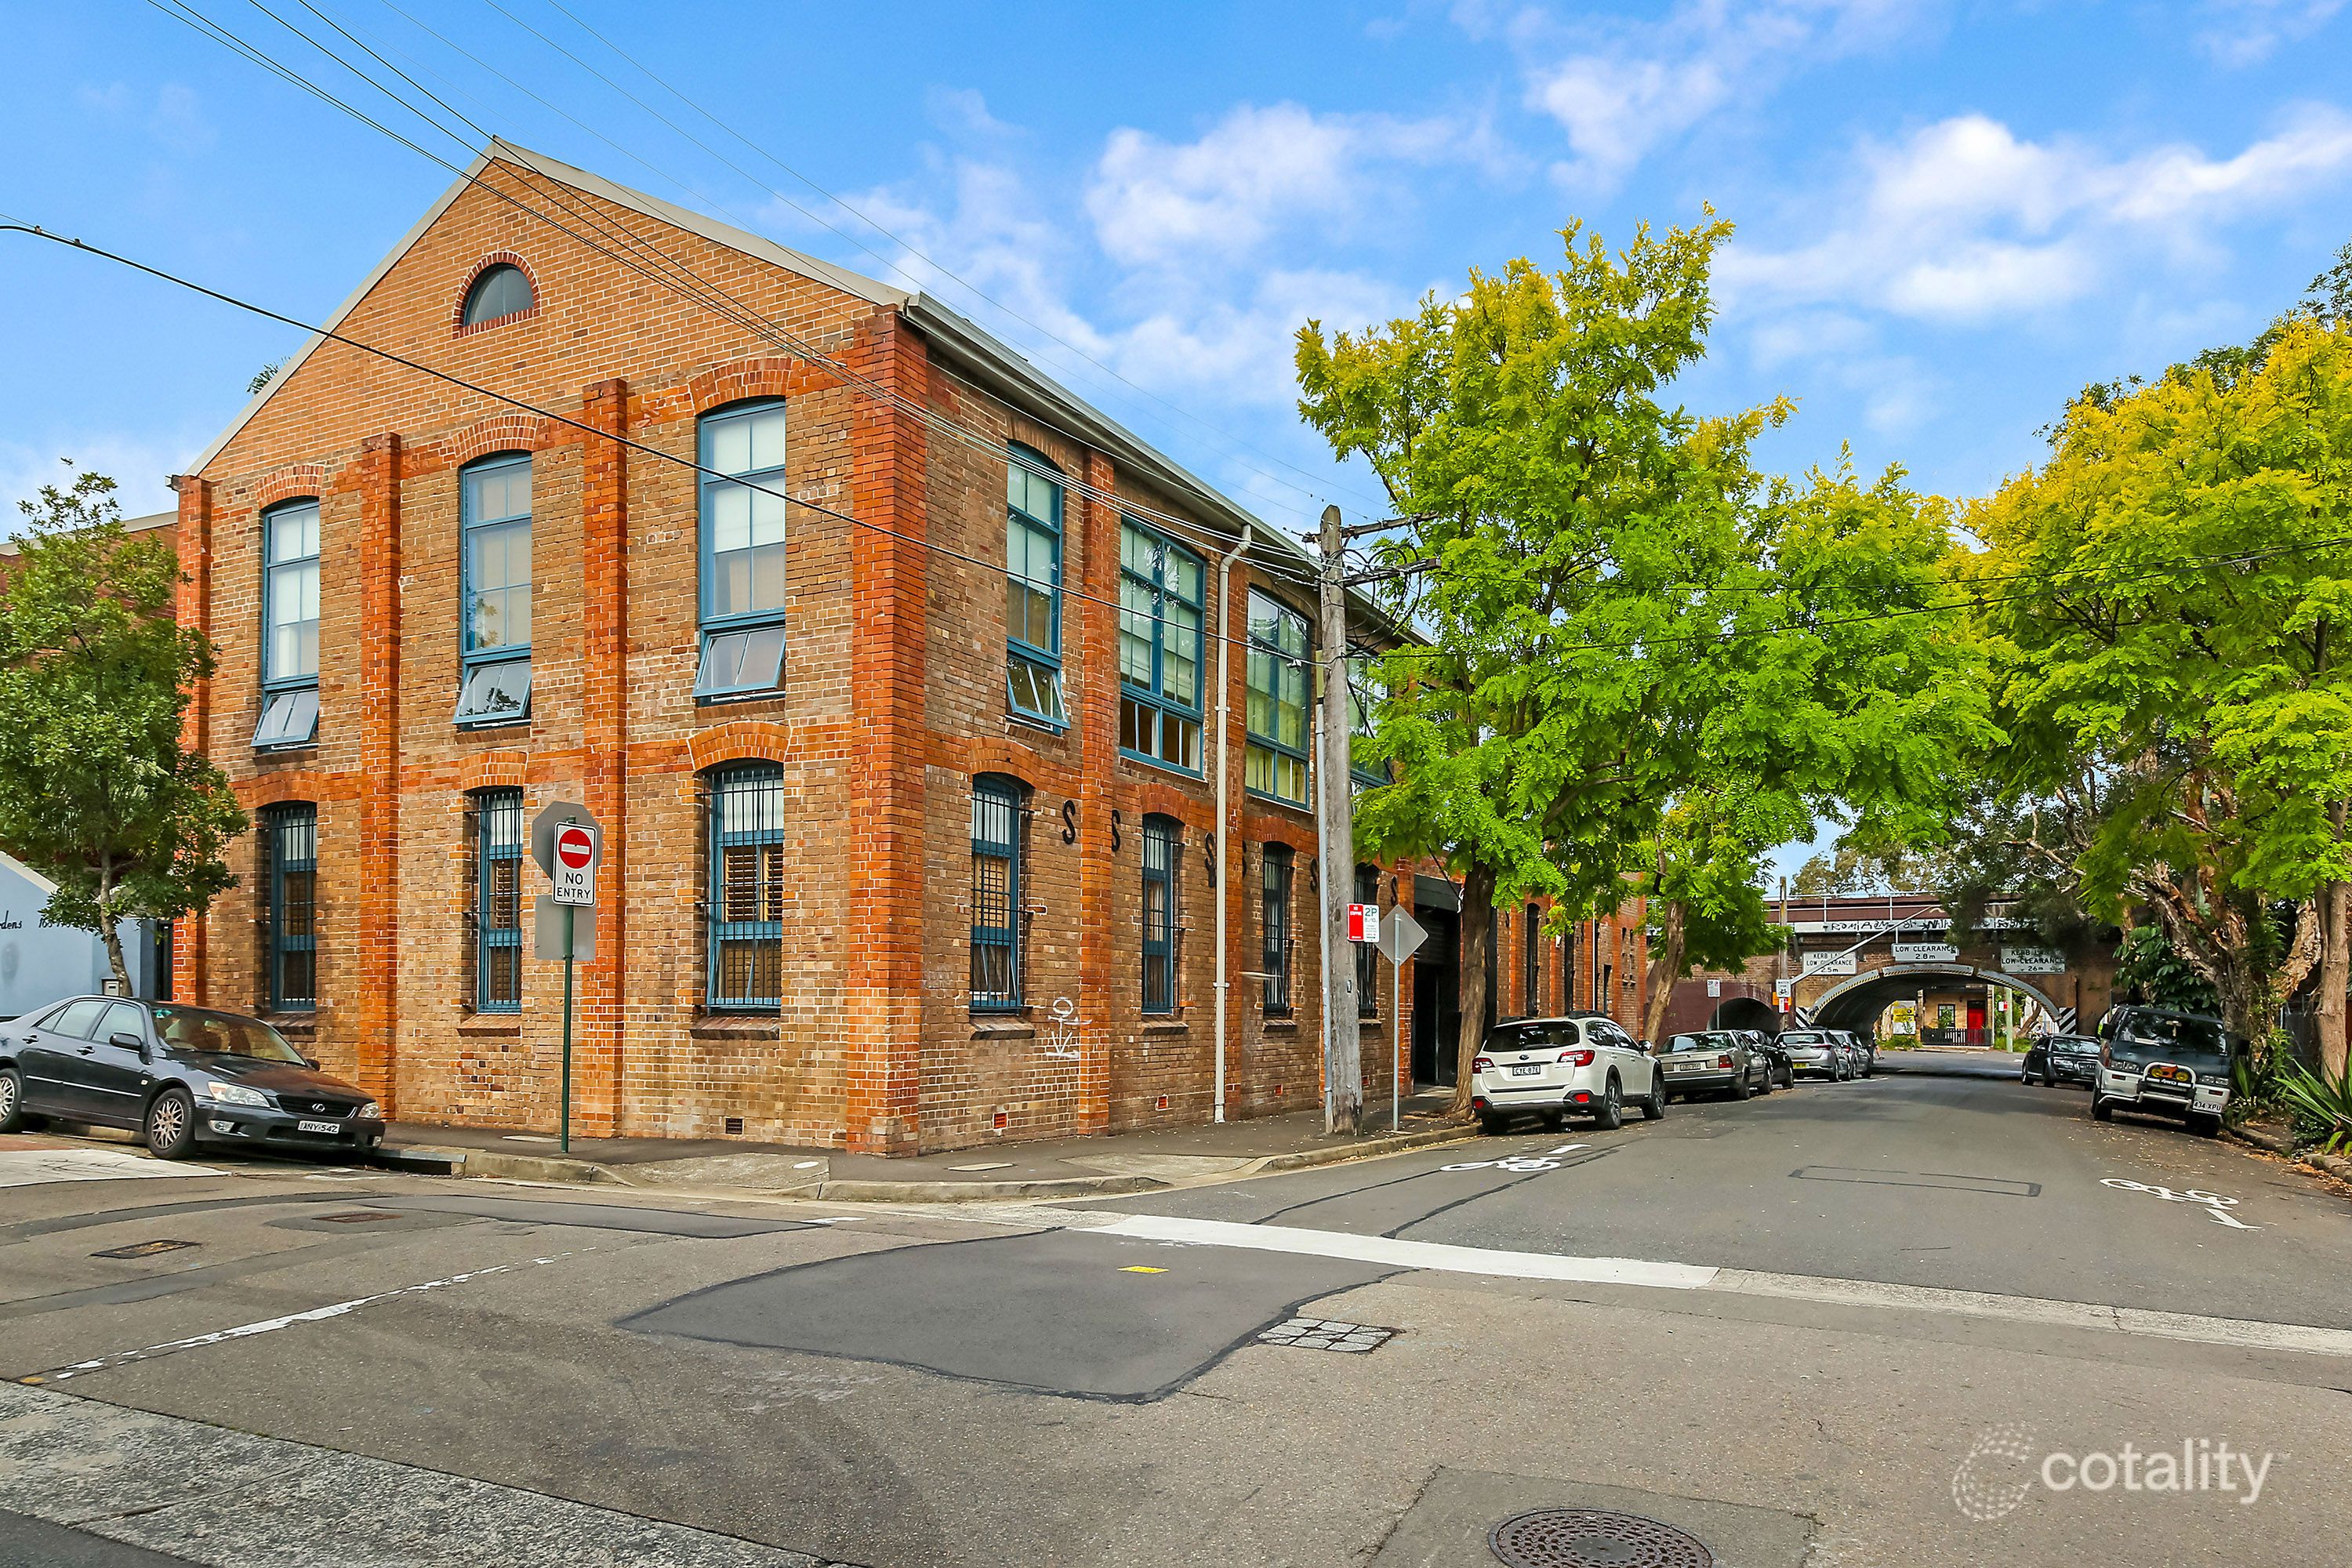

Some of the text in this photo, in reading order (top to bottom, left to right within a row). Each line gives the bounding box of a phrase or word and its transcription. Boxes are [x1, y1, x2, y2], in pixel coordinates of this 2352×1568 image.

[565, 872, 583, 885] NO
[557, 887, 591, 899] ENTRY
[1365, 907, 1377, 916] 2P
